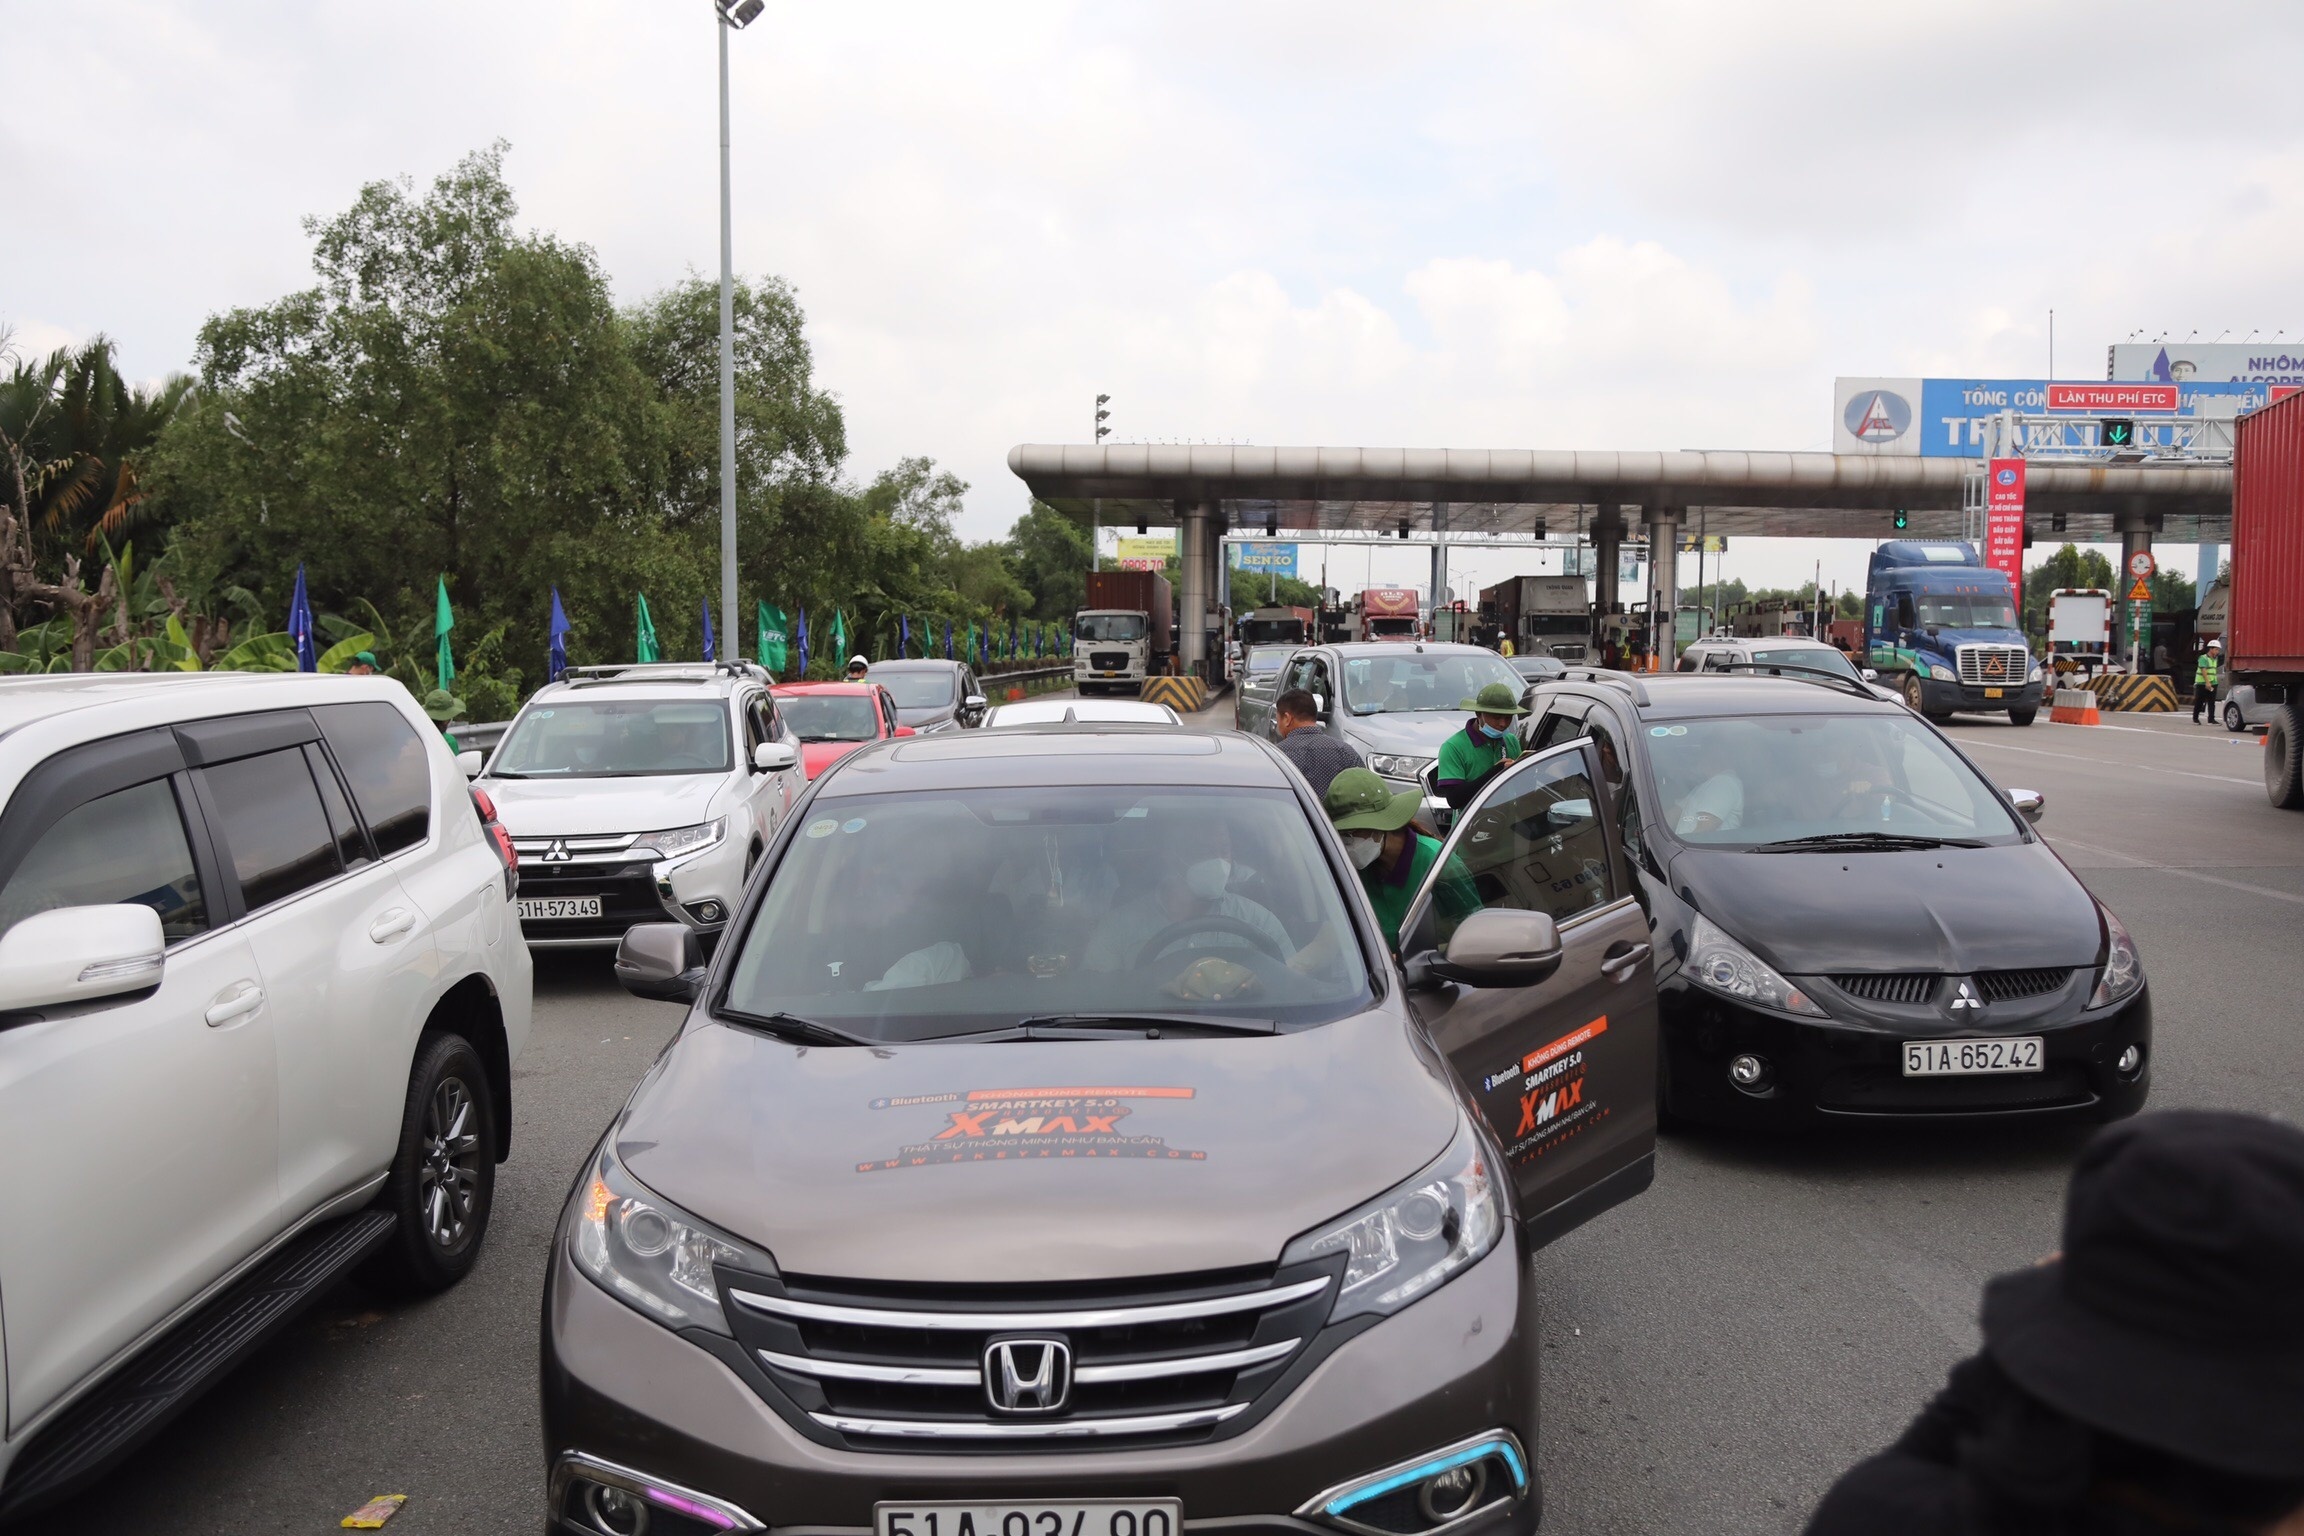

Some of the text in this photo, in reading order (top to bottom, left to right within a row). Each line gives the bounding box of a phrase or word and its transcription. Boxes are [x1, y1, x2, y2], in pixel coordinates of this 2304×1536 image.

[1962, 384, 2007, 406] TỔNG
[2013, 388, 2046, 407] CÔN
[2058, 390, 2166, 404] LÀN THU PHÍ ETC
[1243, 555, 1291, 565] SENKO
[518, 899, 599, 918] 51H-573.49
[1567, 1028, 1592, 1048] REMOTE
[1908, 1042, 2038, 1071] 51A-652.42
[1491, 1063, 1520, 1088] Bluetooth
[1525, 1051, 1582, 1091] SMARTKEY 5.0
[890, 1093, 958, 1107] Bluetooth
[967, 1098, 1118, 1111] SMARTKEY 5.0
[1515, 1077, 1584, 1138] XMAX
[933, 1110, 1121, 1141] XMAX
[1021, 1137, 1059, 1145] MINH
